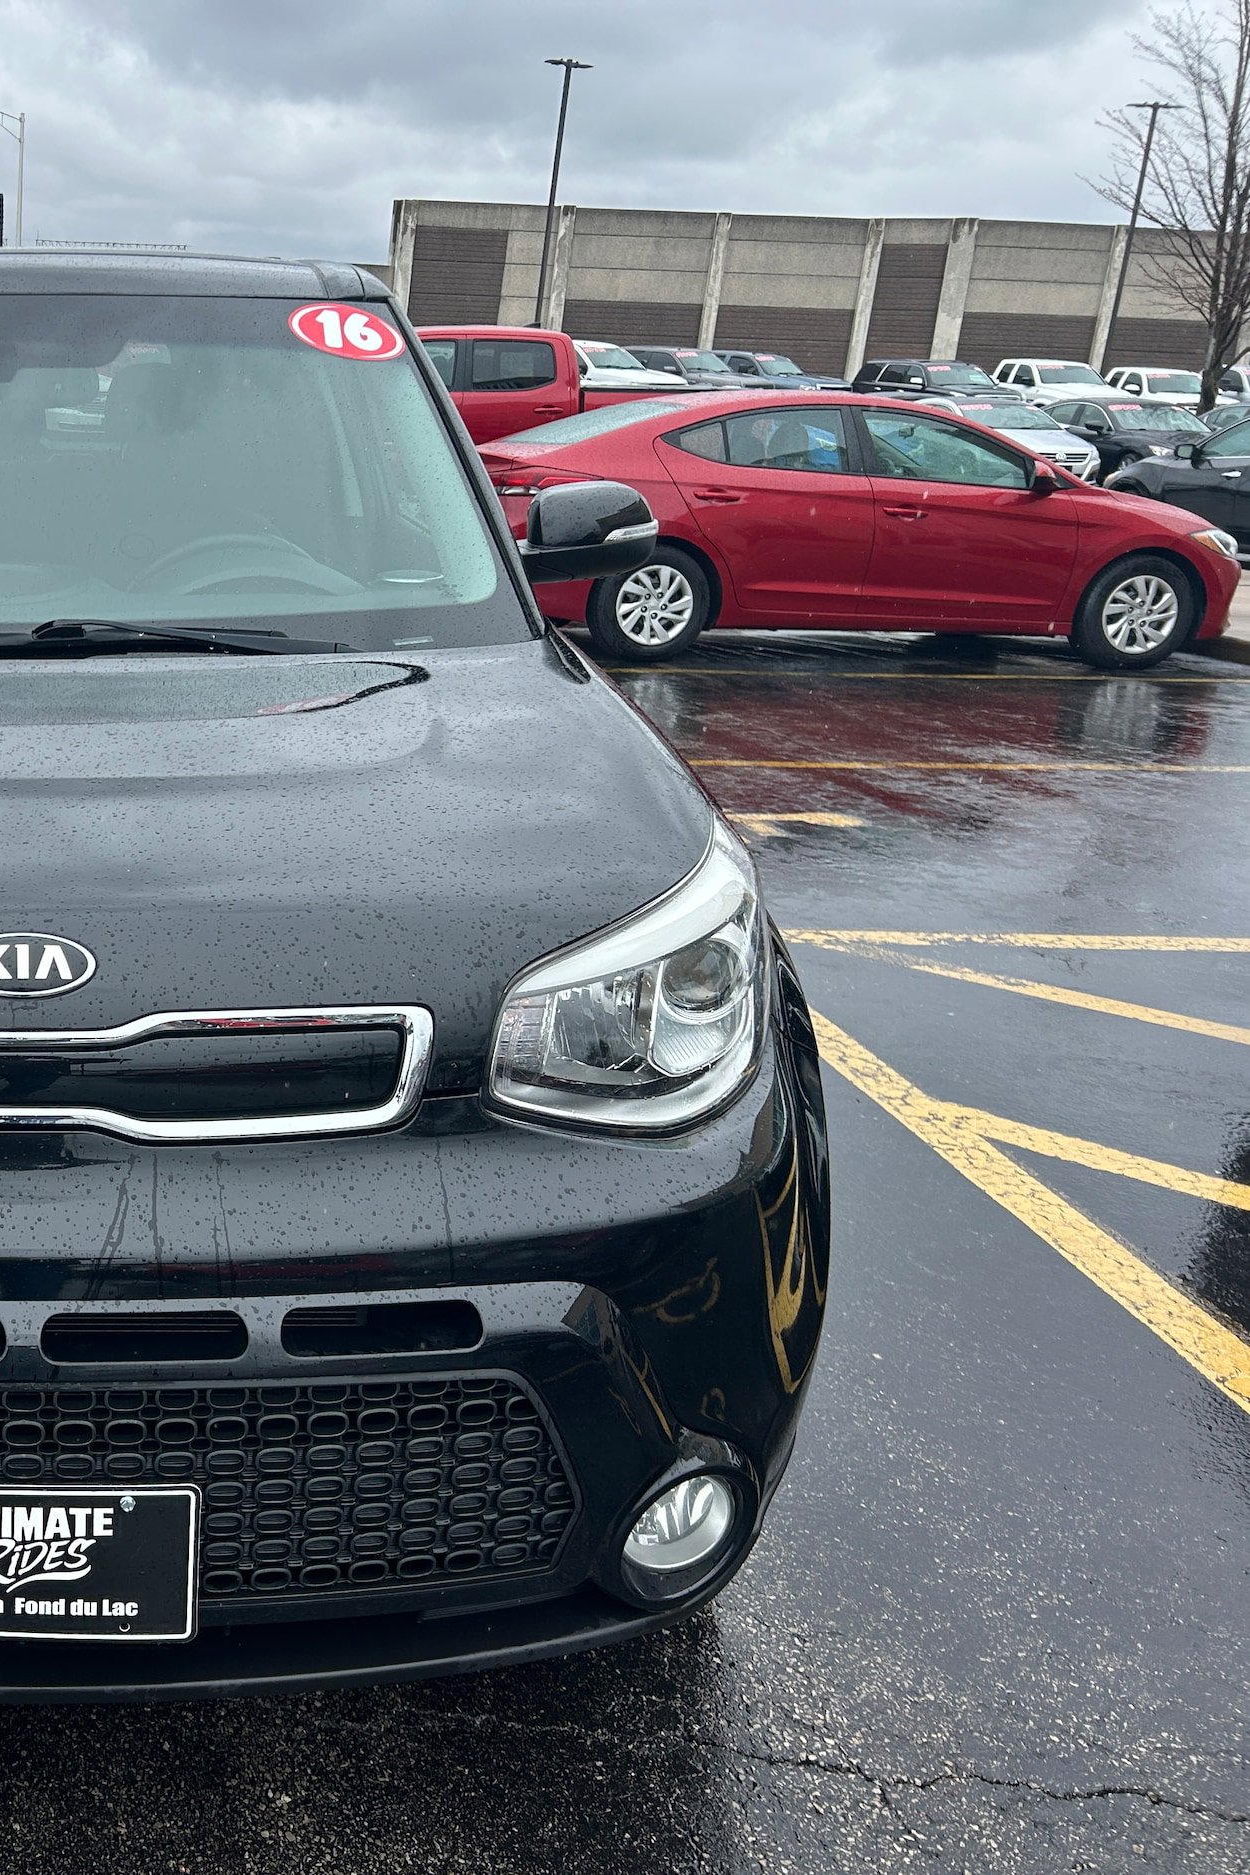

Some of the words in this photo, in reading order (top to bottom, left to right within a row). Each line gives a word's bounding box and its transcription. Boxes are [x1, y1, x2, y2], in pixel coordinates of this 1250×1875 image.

[315, 309, 383, 351] 16
[14, 1597, 66, 1616] Fond
[69, 1598, 98, 1616] du
[101, 1599, 139, 1617] Lac
